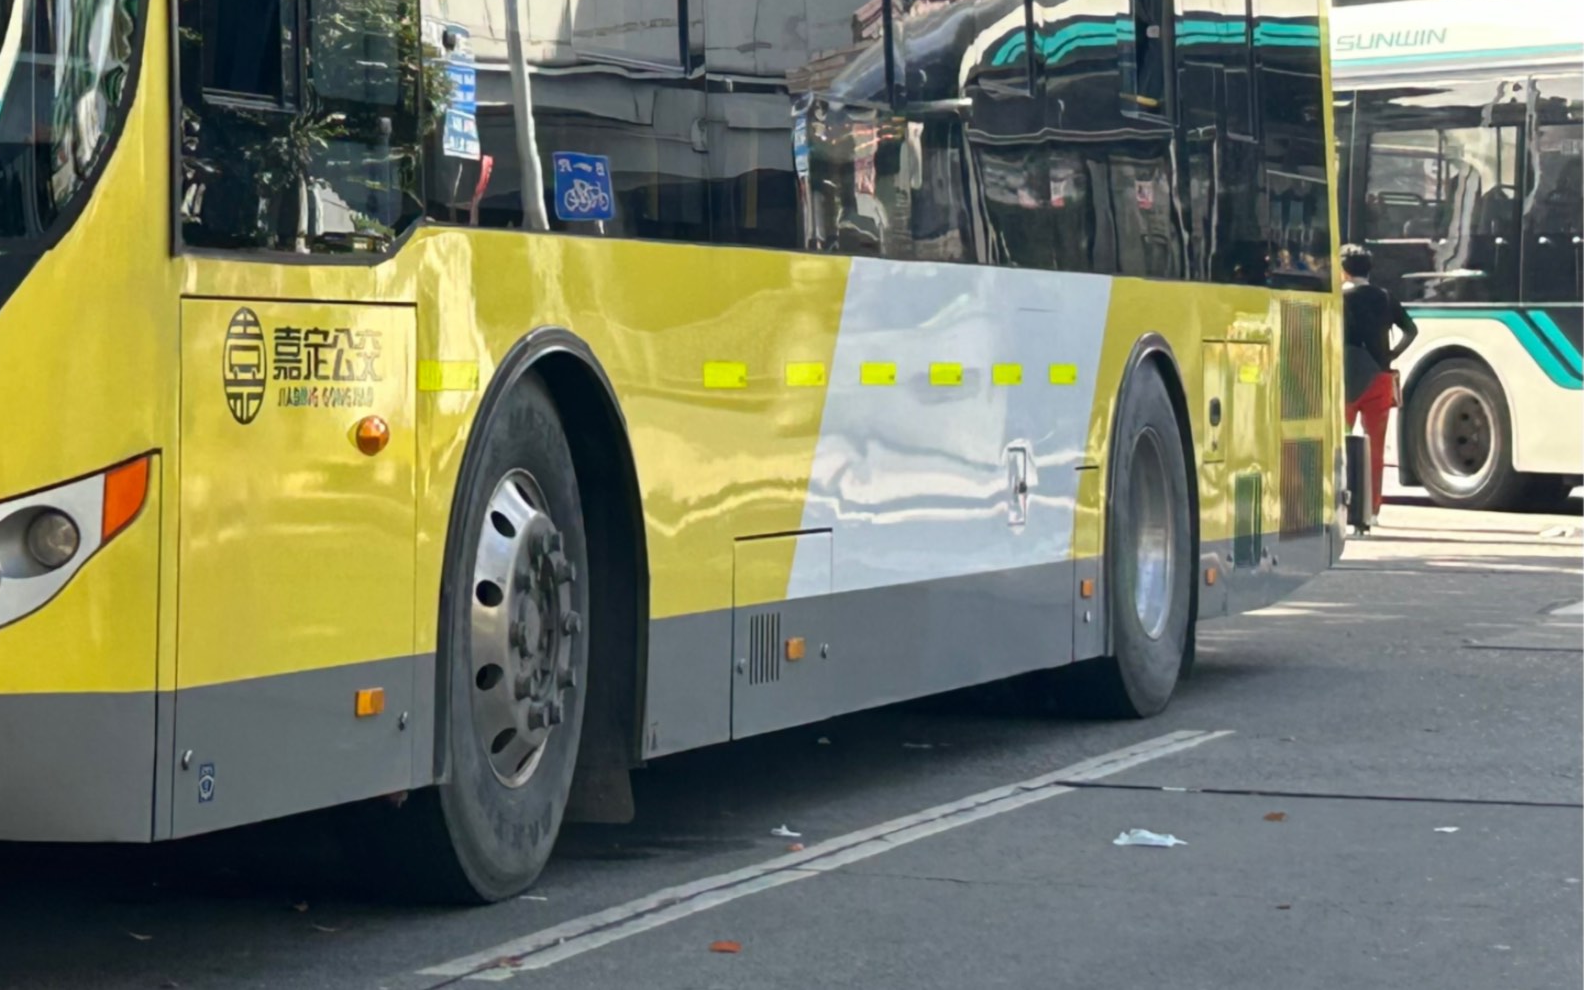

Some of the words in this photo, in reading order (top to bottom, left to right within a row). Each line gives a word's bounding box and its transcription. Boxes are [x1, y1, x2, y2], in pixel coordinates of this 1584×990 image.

[1335, 28, 1447, 51] SUNWIN
[273, 326, 383, 381] 嘉定公交
